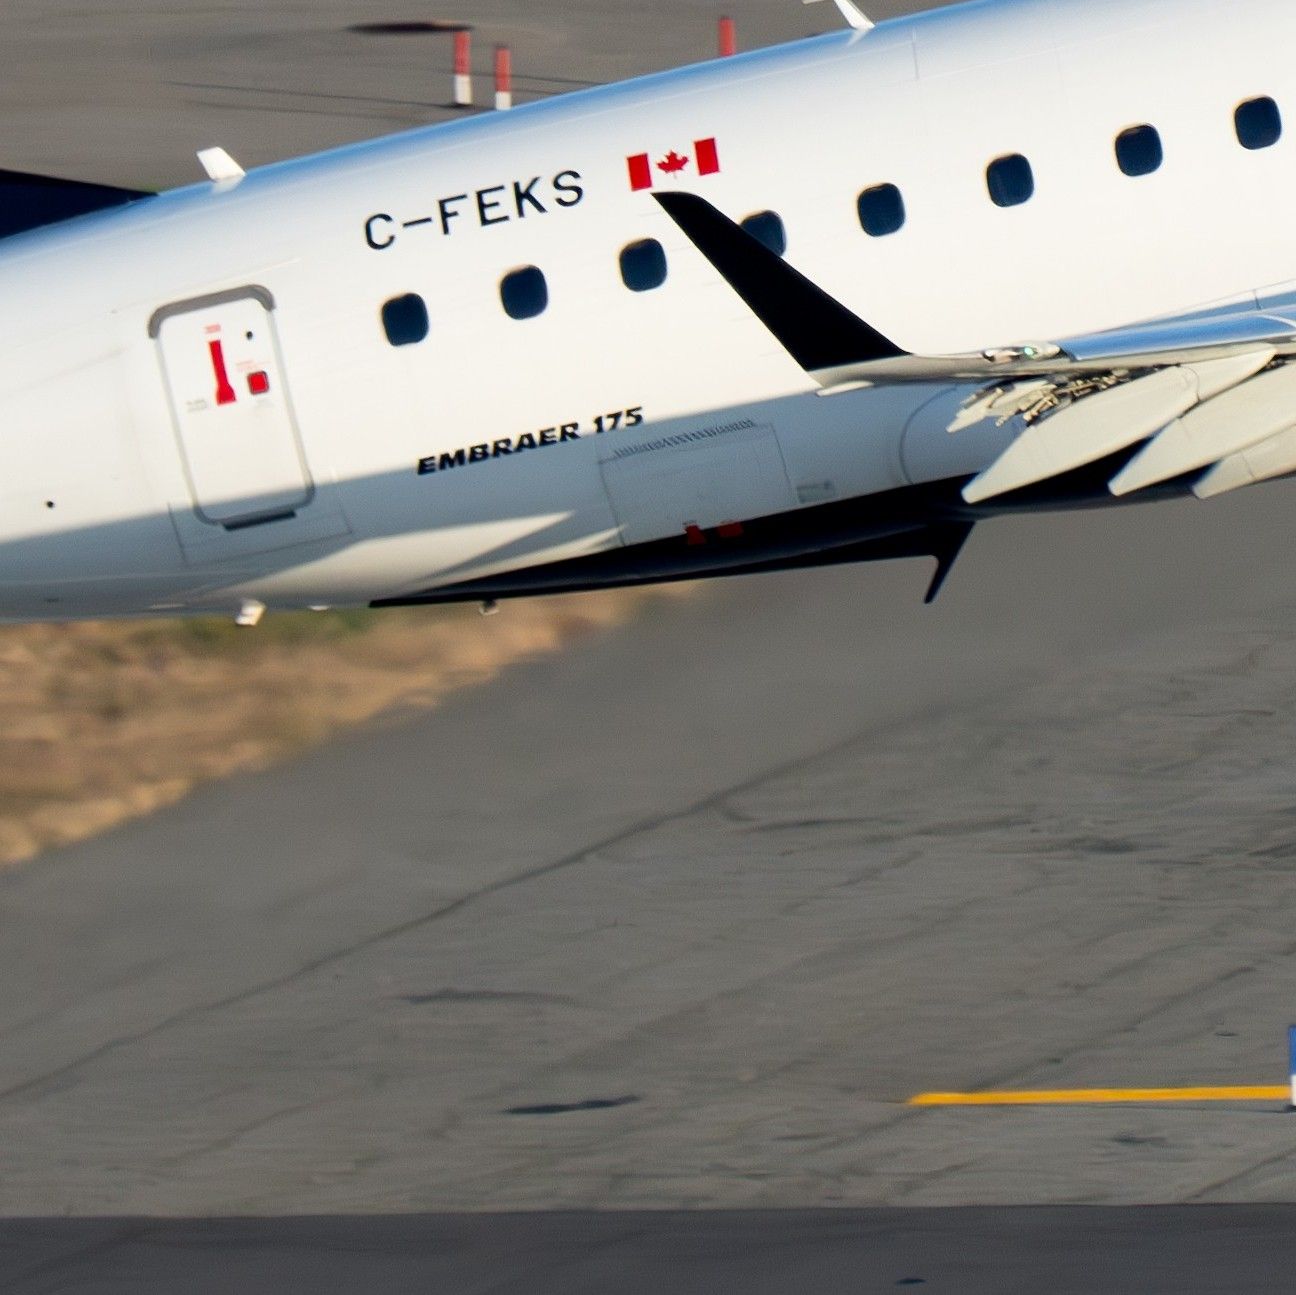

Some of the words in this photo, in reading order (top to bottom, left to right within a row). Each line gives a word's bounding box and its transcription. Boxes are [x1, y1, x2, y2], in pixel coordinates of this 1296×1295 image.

[364, 169, 585, 251] C-FEKS
[416, 421, 582, 477] EMBRAER
[593, 406, 644, 435] 175
